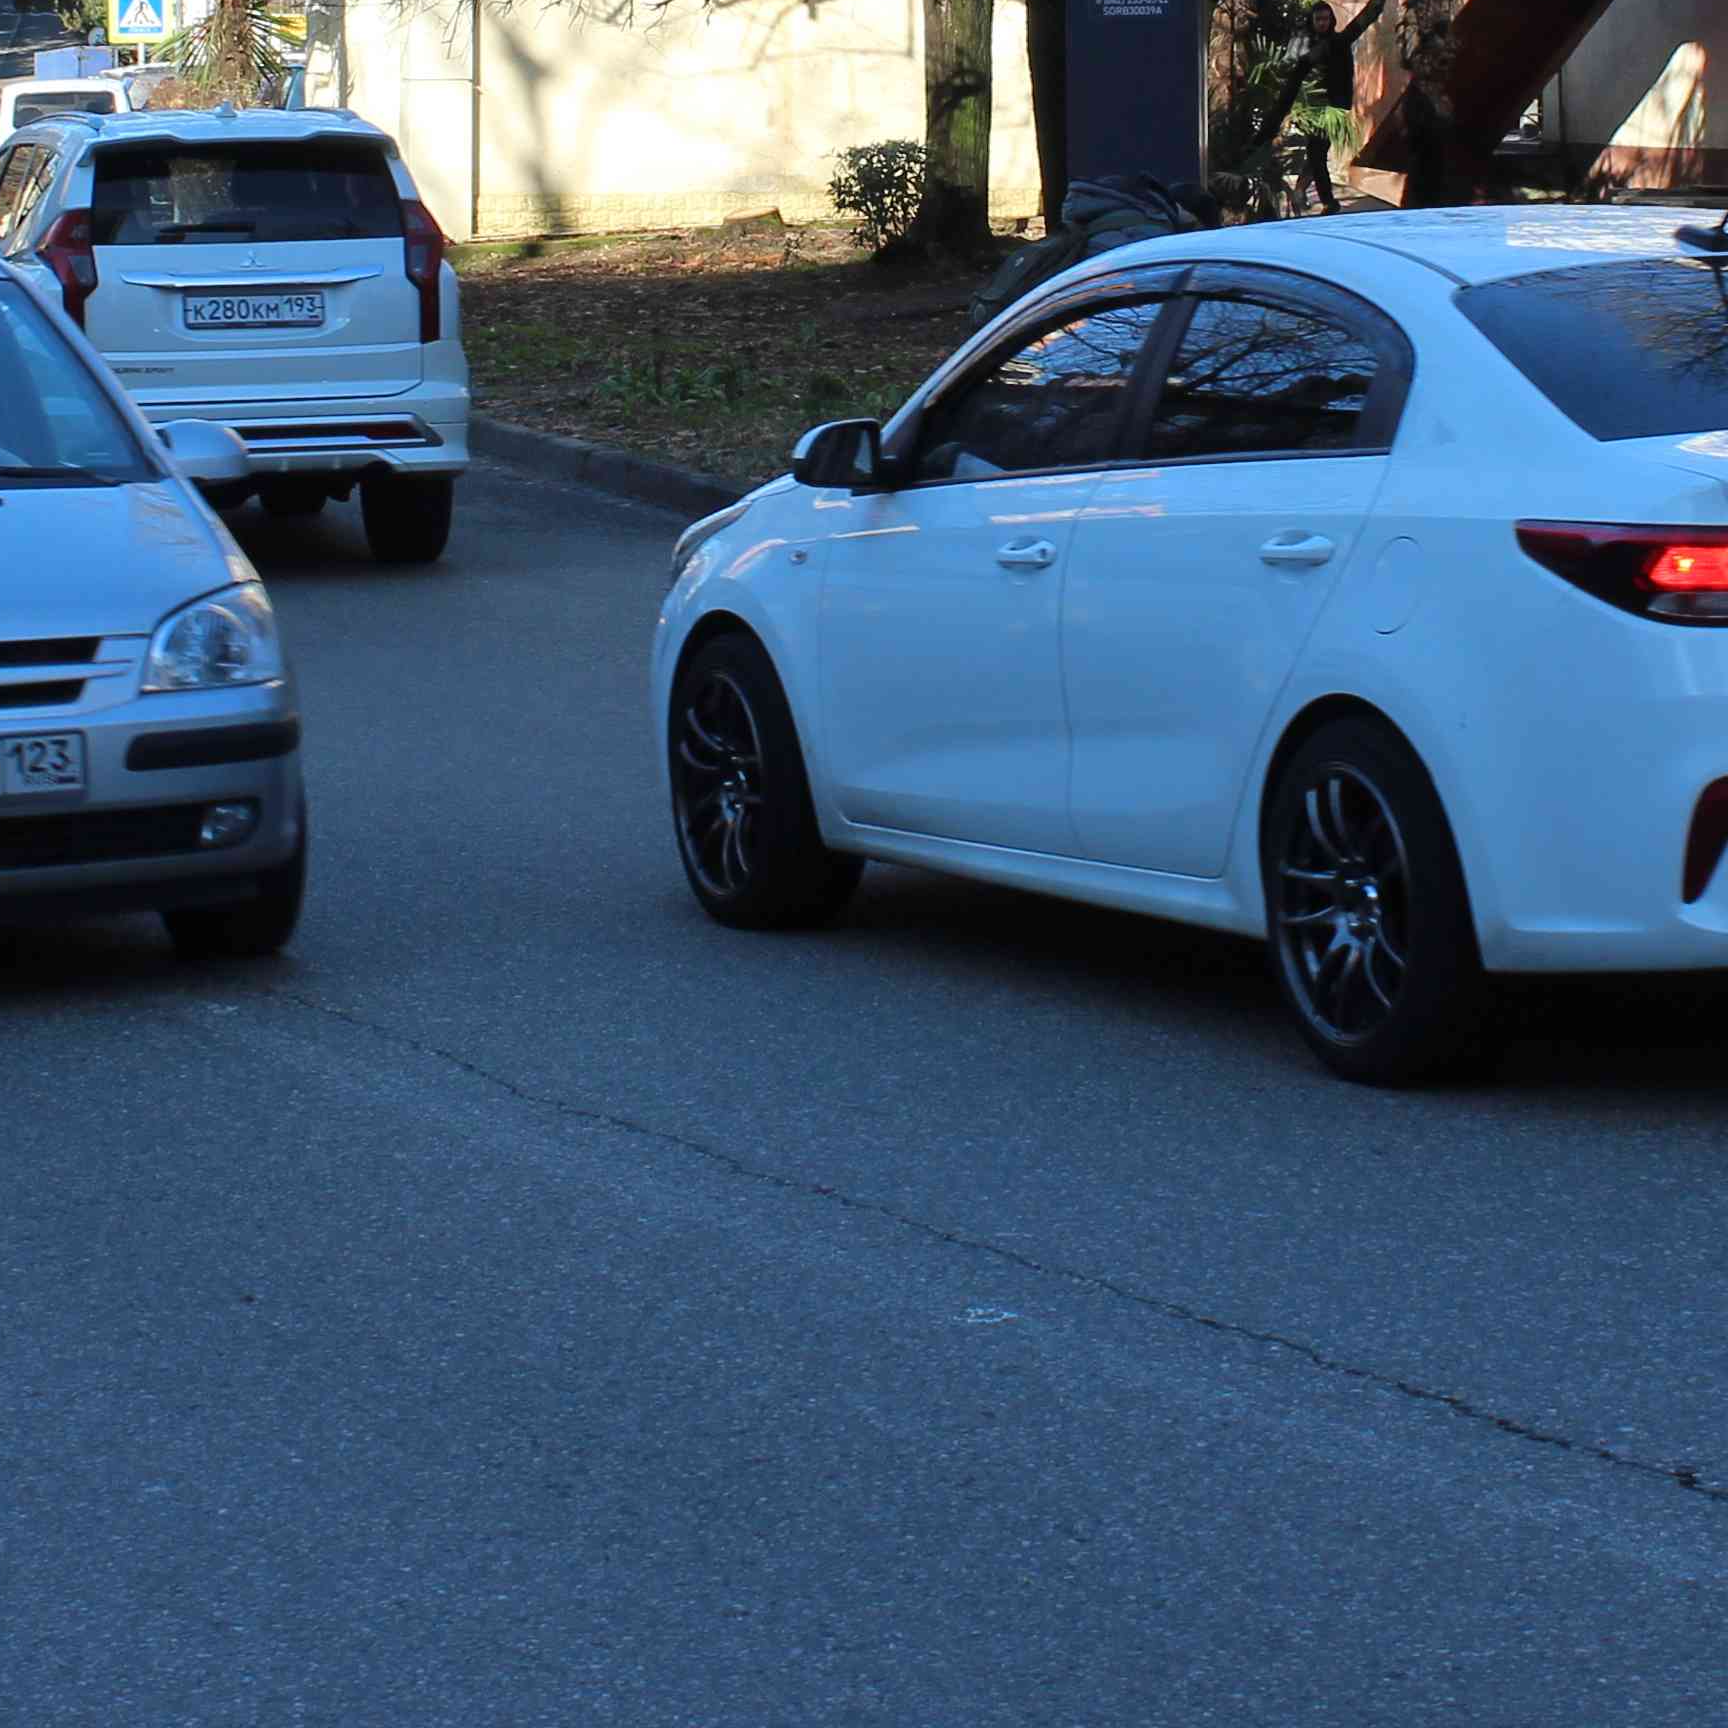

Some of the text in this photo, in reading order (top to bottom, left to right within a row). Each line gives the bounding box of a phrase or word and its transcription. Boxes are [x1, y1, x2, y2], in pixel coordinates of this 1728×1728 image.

[193, 296, 317, 321] К280КМ 193
[3, 739, 71, 774] 123
